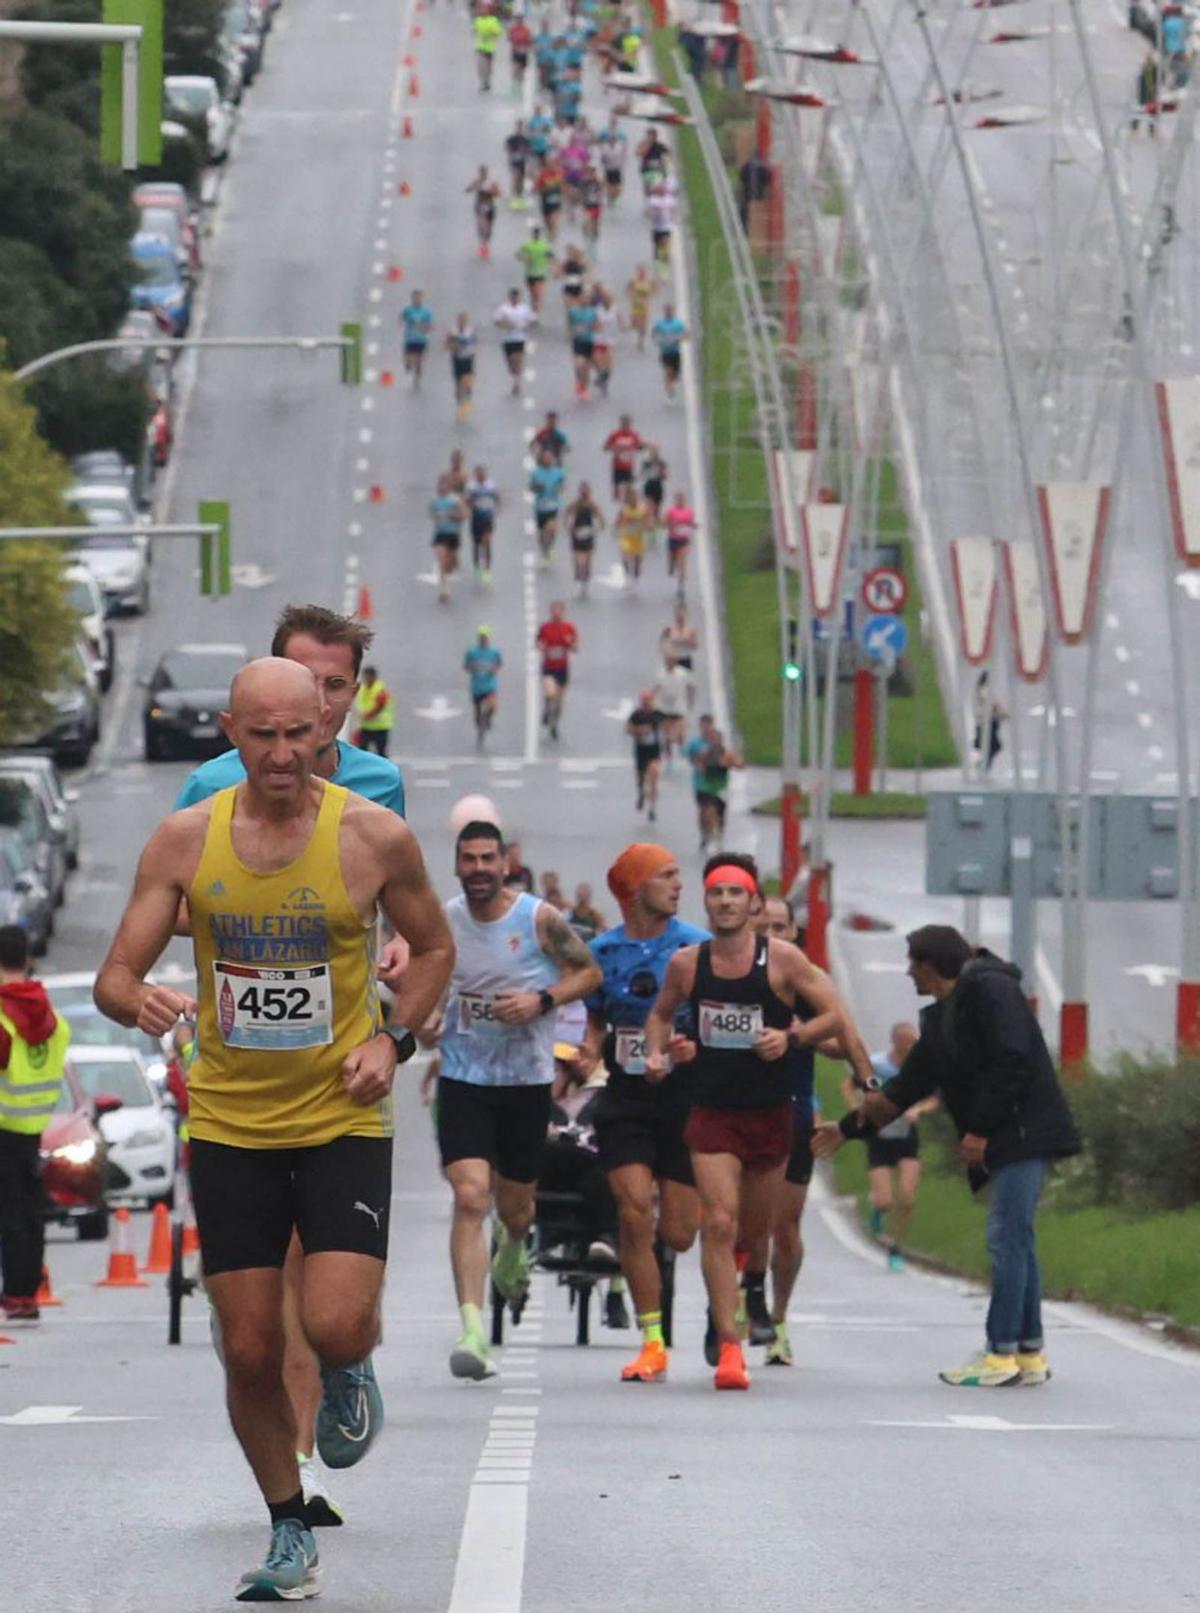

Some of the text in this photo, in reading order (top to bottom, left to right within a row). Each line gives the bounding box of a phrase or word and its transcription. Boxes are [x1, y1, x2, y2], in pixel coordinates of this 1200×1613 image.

[208, 913, 327, 938] ATHLETICS
[237, 986, 313, 1021] 452
[711, 1013, 752, 1032] 488
